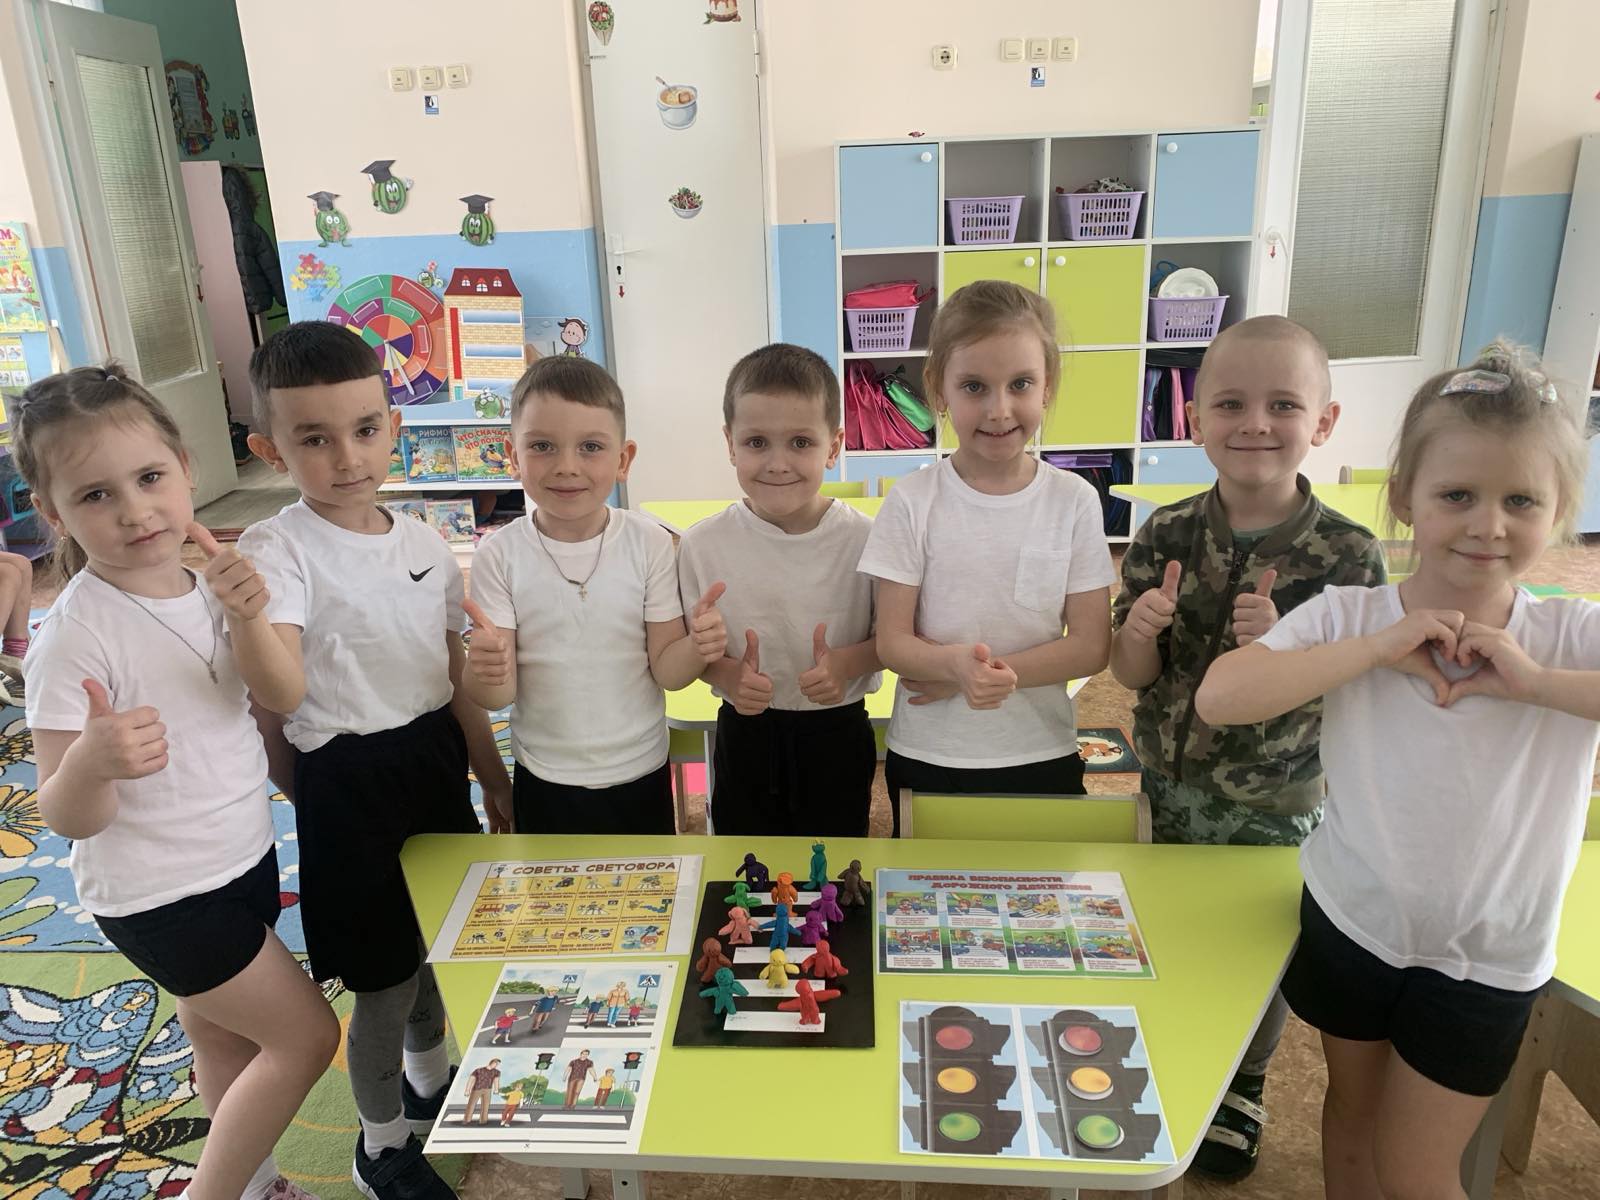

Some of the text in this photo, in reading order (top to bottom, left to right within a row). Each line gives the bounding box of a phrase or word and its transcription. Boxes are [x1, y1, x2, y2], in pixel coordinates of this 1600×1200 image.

[457, 432, 474, 442] ЧТО
[465, 440, 480, 450] ЧТО
[512, 862, 676, 875] СОВЕТЫ СВЕТОФОРА
[931, 882, 1012, 890] ДОРОЖНОГО
